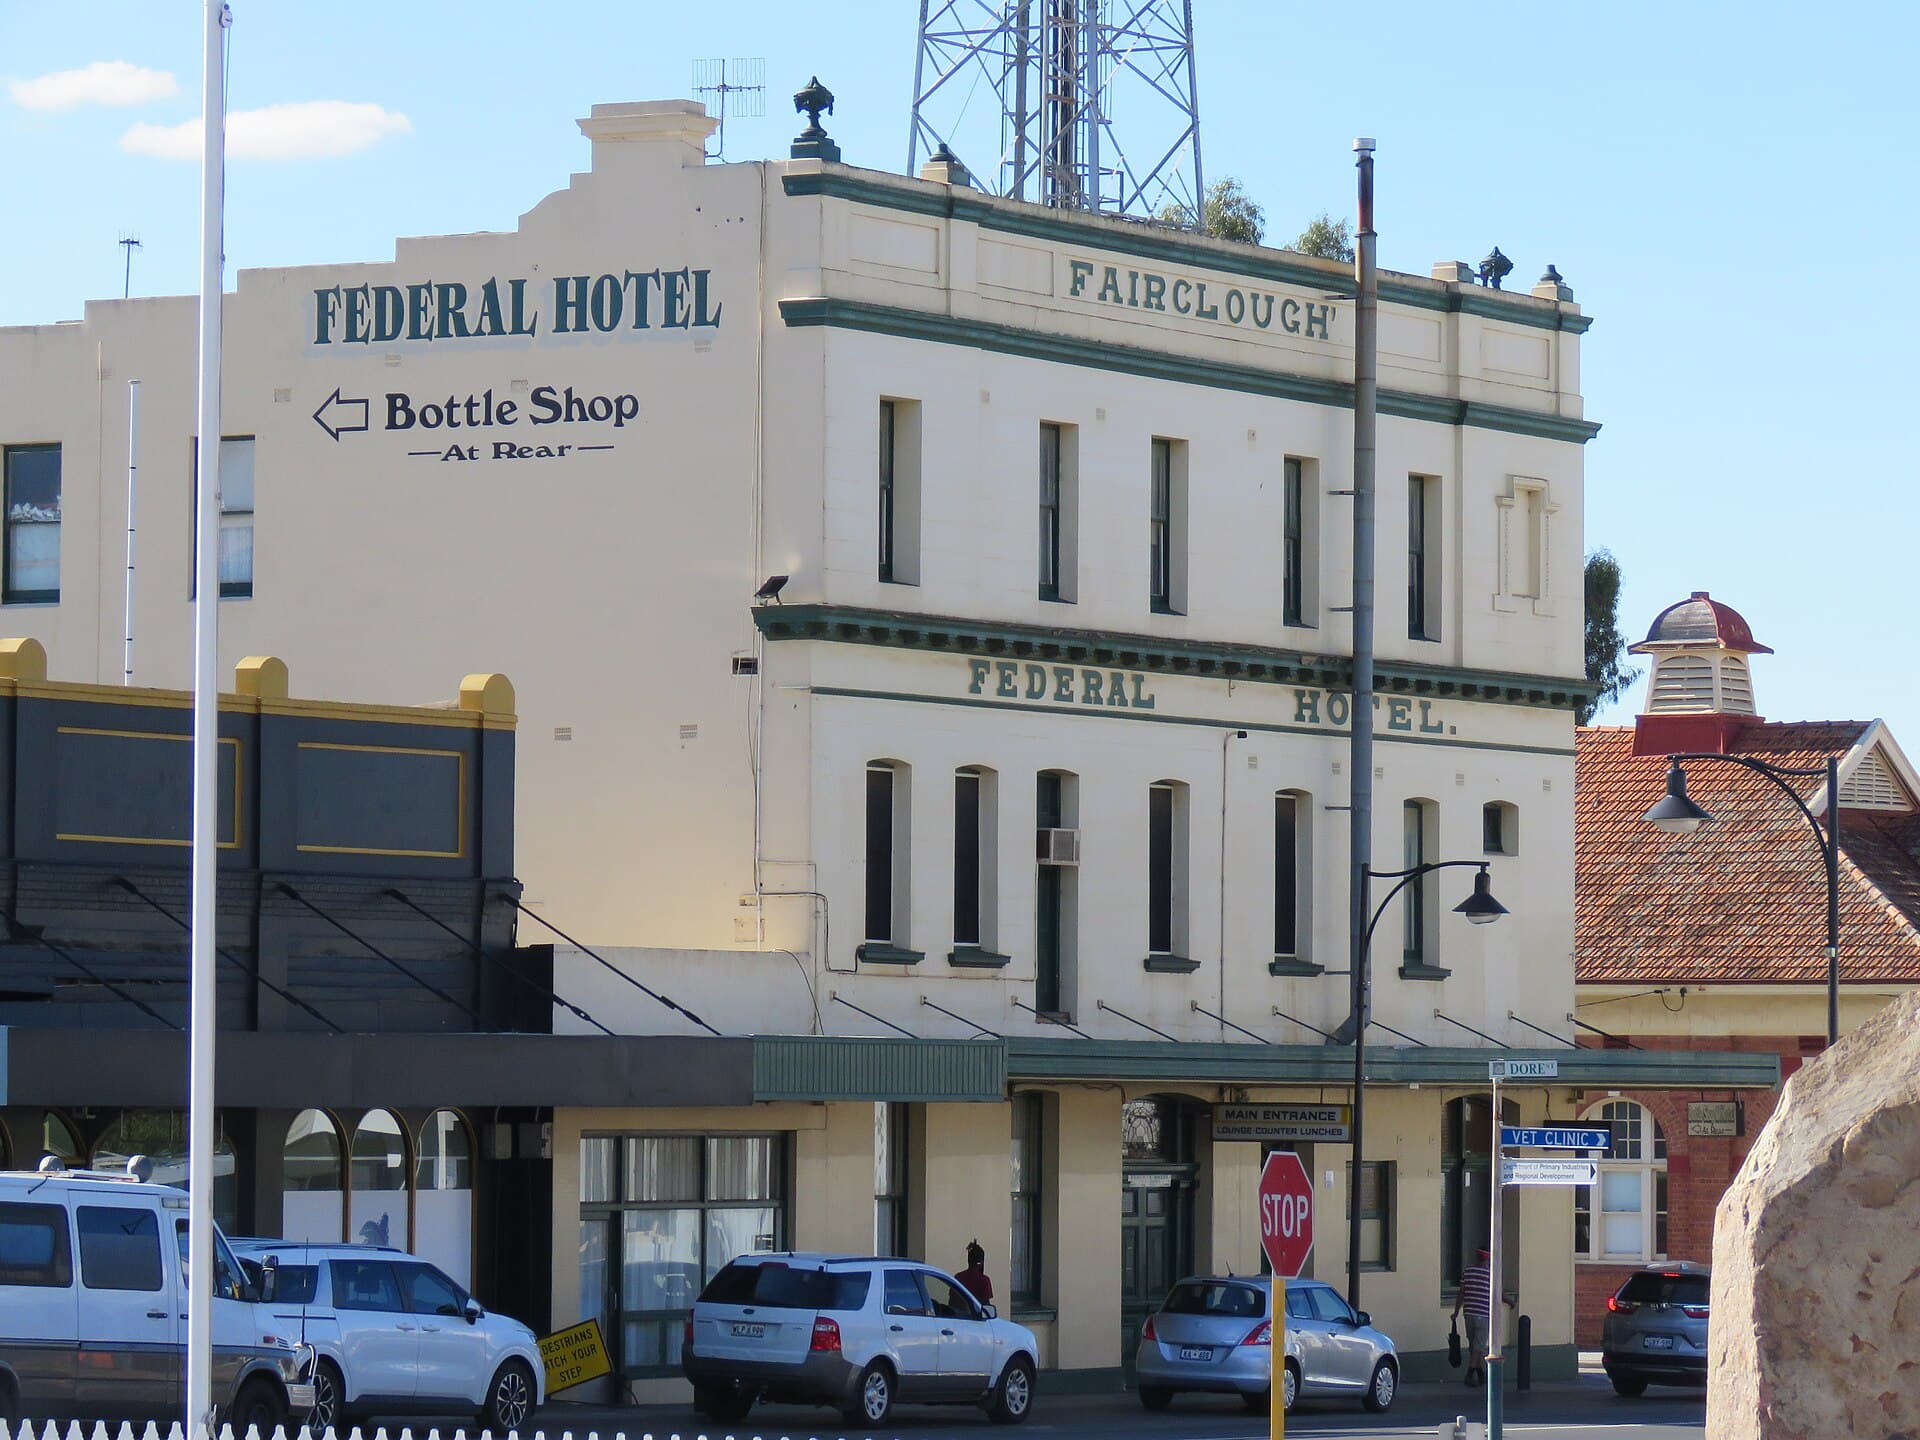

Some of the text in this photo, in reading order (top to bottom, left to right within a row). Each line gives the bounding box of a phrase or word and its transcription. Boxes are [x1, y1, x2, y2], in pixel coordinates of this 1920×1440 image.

[313, 265, 723, 345] FEDERAL HOTEL
[384, 385, 640, 432] Bottle Shop
[440, 440, 573, 462] At Rear
[968, 658, 1458, 736] FEDERAL HOEL.
[1510, 1062, 1545, 1075] DORE
[1225, 1109, 1336, 1122] MAIN ENTRANCE
[1217, 1126, 1342, 1137] LOUNGE COUNTER LUNCHES
[1512, 1130, 1589, 1146] VET CLINIC
[1515, 1172, 1539, 1180] Regional
[1540, 1172, 1575, 1180] Development
[1540, 1163, 1560, 1172] Primary
[1561, 1163, 1589, 1171] Industries
[1262, 1193, 1309, 1238] STOP
[541, 1328, 593, 1355] DESTRIANS
[544, 1344, 597, 1370] ATCH YOUR
[560, 1366, 582, 1383] STEP
